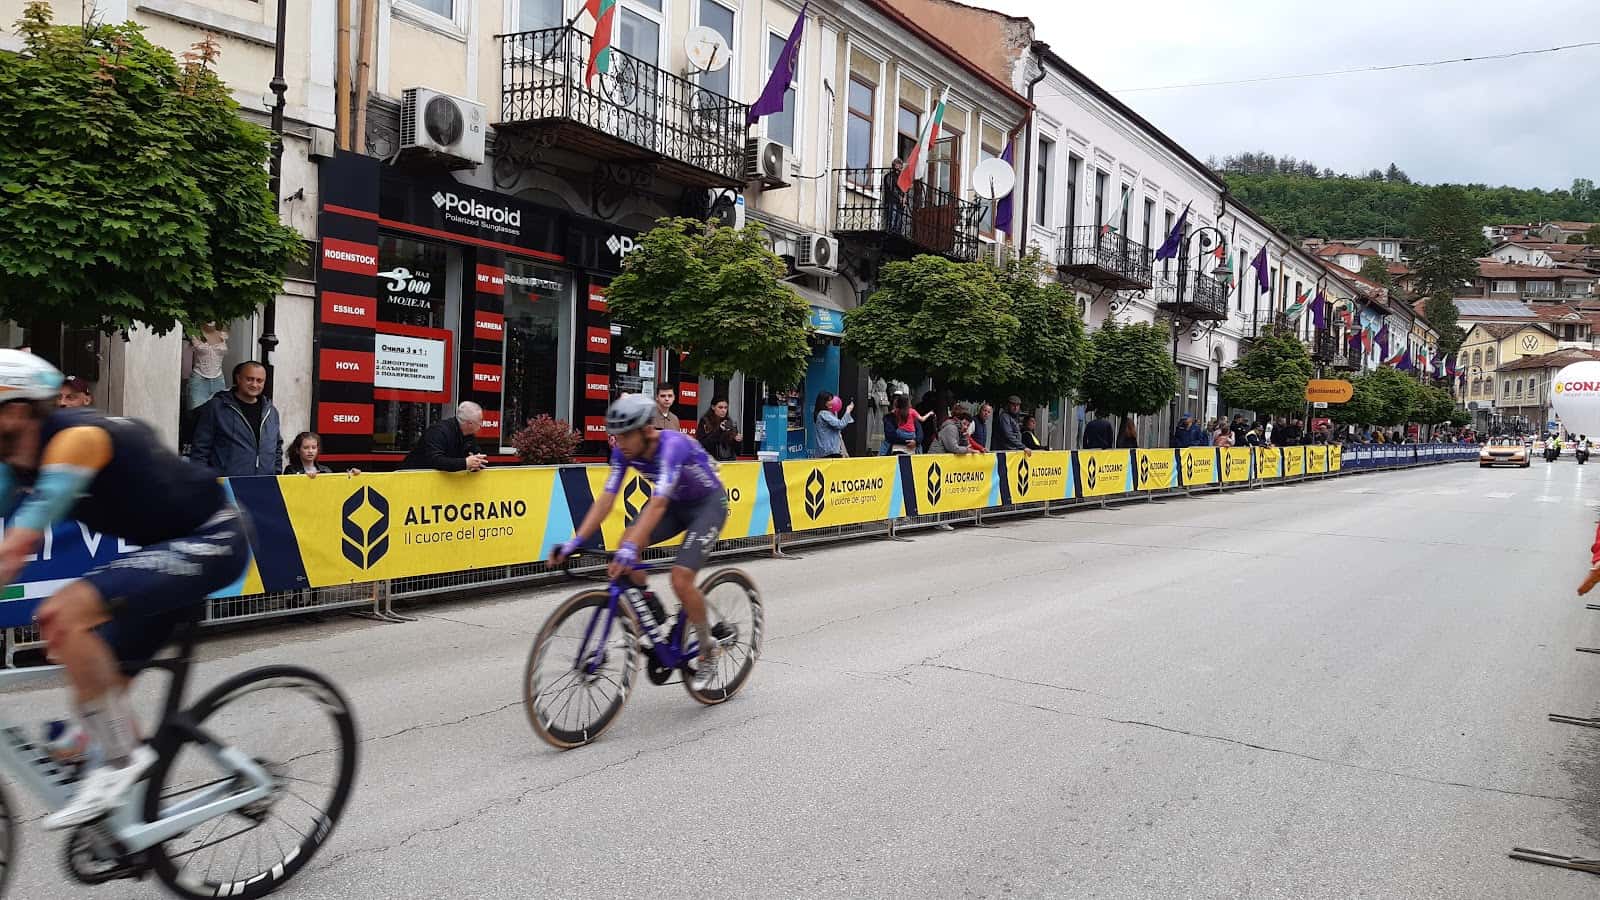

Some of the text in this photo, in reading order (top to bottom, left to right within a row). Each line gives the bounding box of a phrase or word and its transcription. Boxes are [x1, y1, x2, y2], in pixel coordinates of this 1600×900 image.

[445, 192, 521, 227] Polaroid
[445, 213, 521, 235] Polarized Sunglasses
[325, 249, 376, 266] RODENSTOCK
[387, 295, 431, 309] МОДЕЛА
[333, 304, 366, 316] ESSILOR
[476, 321, 502, 331] CARRERA
[335, 361, 360, 370] HOYA
[474, 373, 501, 382] REPLAY
[333, 414, 360, 423] SEIKO
[944, 471, 985, 484] ALTOGRANO
[1032, 467, 1062, 477] ALTOGRANO
[830, 478, 884, 494] ALTOGRANO
[404, 500, 527, 525] ALTOGRANO
[404, 525, 514, 545] Il cuore del grano
